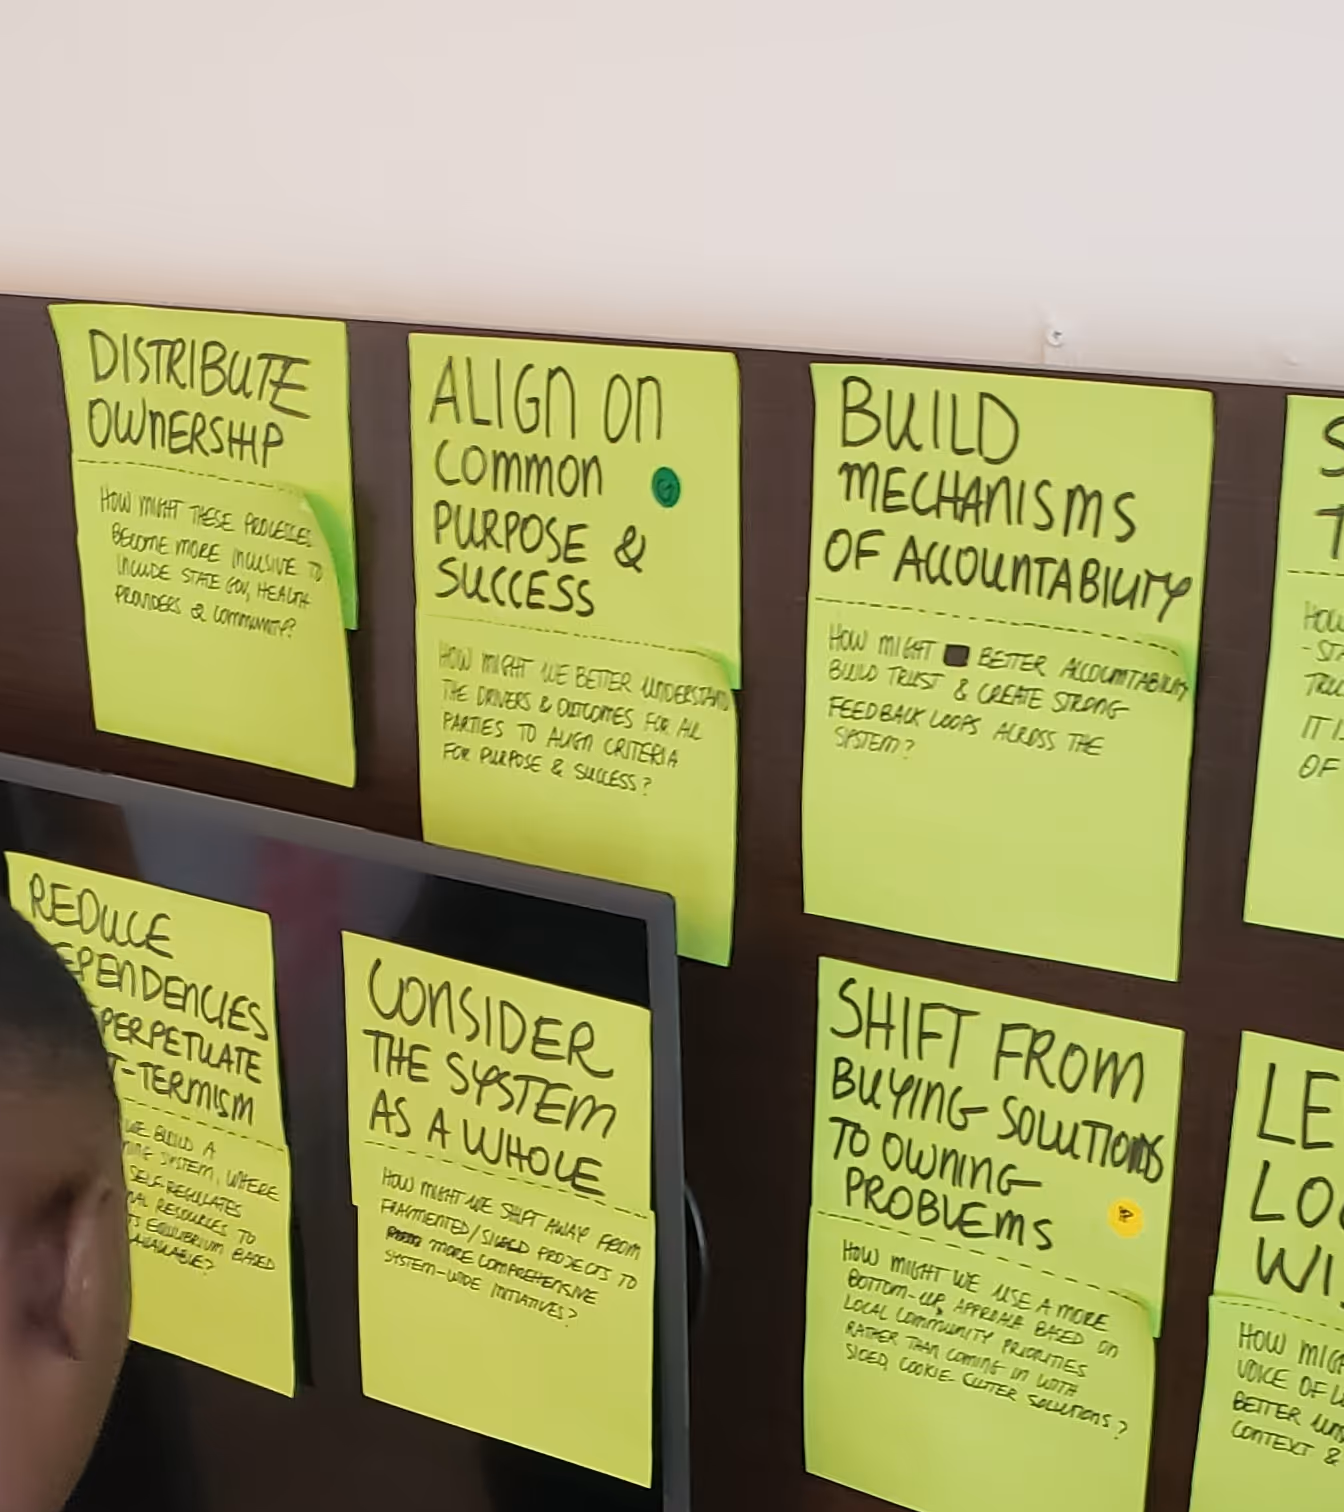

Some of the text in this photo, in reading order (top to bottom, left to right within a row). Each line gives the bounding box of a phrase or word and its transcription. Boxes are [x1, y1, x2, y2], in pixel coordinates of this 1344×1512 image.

[88, 329, 311, 419] DISTRIBUTE
[428, 356, 663, 444] ALIGN ON
[88, 397, 284, 468] OWNERSHIP
[841, 376, 1020, 465] BUILD
[189, 505, 235, 531] THESE
[433, 500, 646, 573] PURPOSE &
[838, 461, 1136, 543] MECHANISMS
[176, 539, 220, 562] MORE
[435, 556, 595, 617] SUCCESS
[824, 528, 1193, 624] OF ACCOUNTABILITY
[191, 603, 206, 621] &
[576, 666, 632, 692] BETTER
[887, 666, 1130, 719] TRUST & CREATE STRONG
[443, 711, 504, 737] PARTIES
[518, 723, 537, 743] TO
[604, 737, 678, 768] CRITERIA
[480, 746, 542, 772] PURPOSE
[828, 696, 1105, 756] FEEDBACK LOOPS ACROSS THE
[1298, 754, 1342, 779] OF
[29, 873, 174, 959] REDUCE
[53, 941, 269, 1042] EPENDENCIES
[367, 958, 614, 1080] CONSIDER
[830, 977, 1144, 1103] SHIFT FROM
[362, 1029, 617, 1139] THE SYSTEM
[832, 1056, 1165, 1184] BUYING SOLUTIONS
[369, 1089, 606, 1197] AS A WHOLE
[828, 1116, 1043, 1196] TO OWNING
[238, 1229, 256, 1244] TO
[383, 1167, 590, 1243] HOW AWAY
[846, 1165, 1053, 1251] PROBLEMS
[429, 1238, 474, 1264] MORE
[537, 1246, 637, 1289] PROJECTS TO
[843, 1239, 1110, 1332] HOW MIGHT WE USE A MORE
[1233, 1391, 1301, 1425] BETTER
[1237, 1359, 1290, 1390] VOICE
[1298, 1375, 1327, 1398] OF
